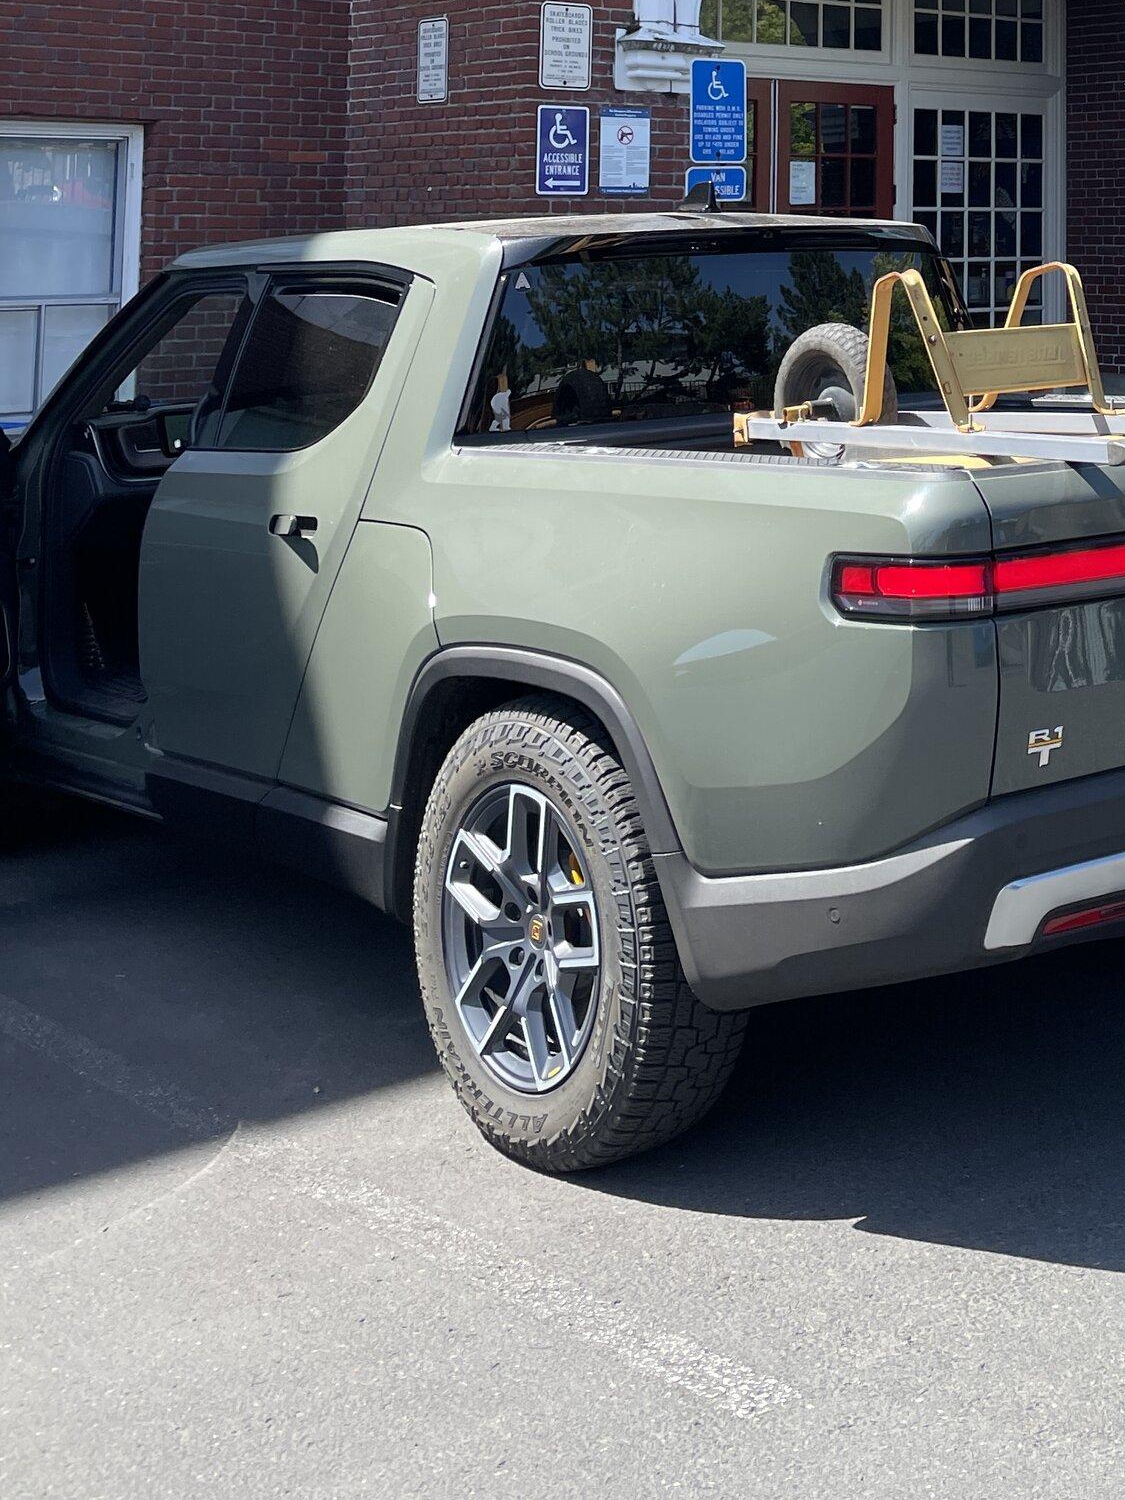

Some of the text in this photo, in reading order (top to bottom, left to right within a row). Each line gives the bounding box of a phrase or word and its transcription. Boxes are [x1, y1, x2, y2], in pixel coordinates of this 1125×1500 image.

[549, 11, 585, 19] SKATEBOARDS
[552, 36, 581, 44] PROHIBITED
[543, 153, 583, 163] ACCESSIBLE
[545, 165, 580, 175] ENTRANCE
[711, 172, 726, 182] VAN
[490, 751, 594, 848] SCORPION
